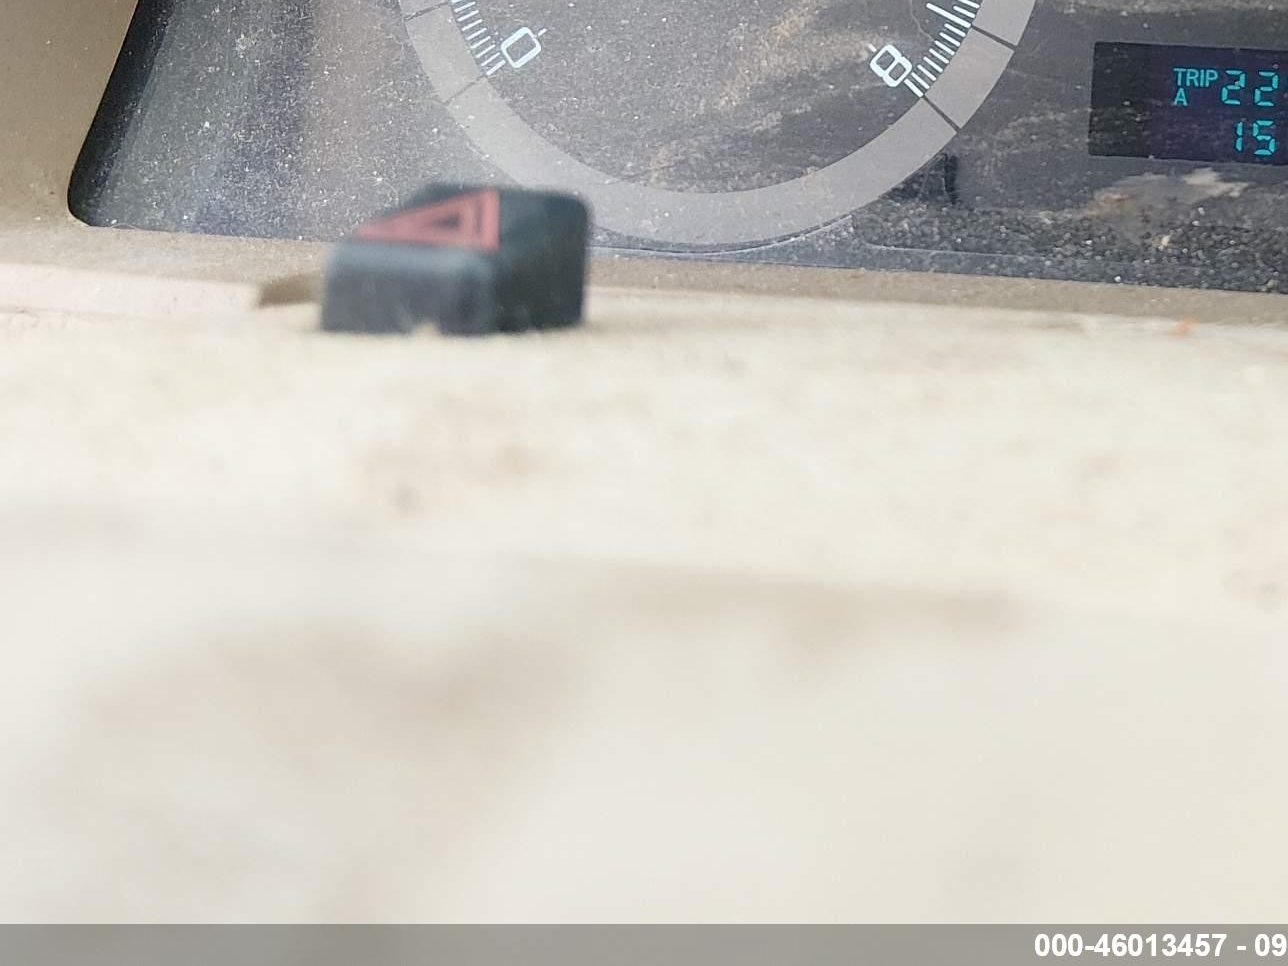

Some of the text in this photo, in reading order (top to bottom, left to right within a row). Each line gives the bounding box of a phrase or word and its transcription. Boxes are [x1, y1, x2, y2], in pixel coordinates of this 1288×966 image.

[500, 26, 541, 68] 0
[870, 44, 912, 87] 8
[1173, 68, 1219, 89] TRIP
[1174, 89, 1188, 107] A
